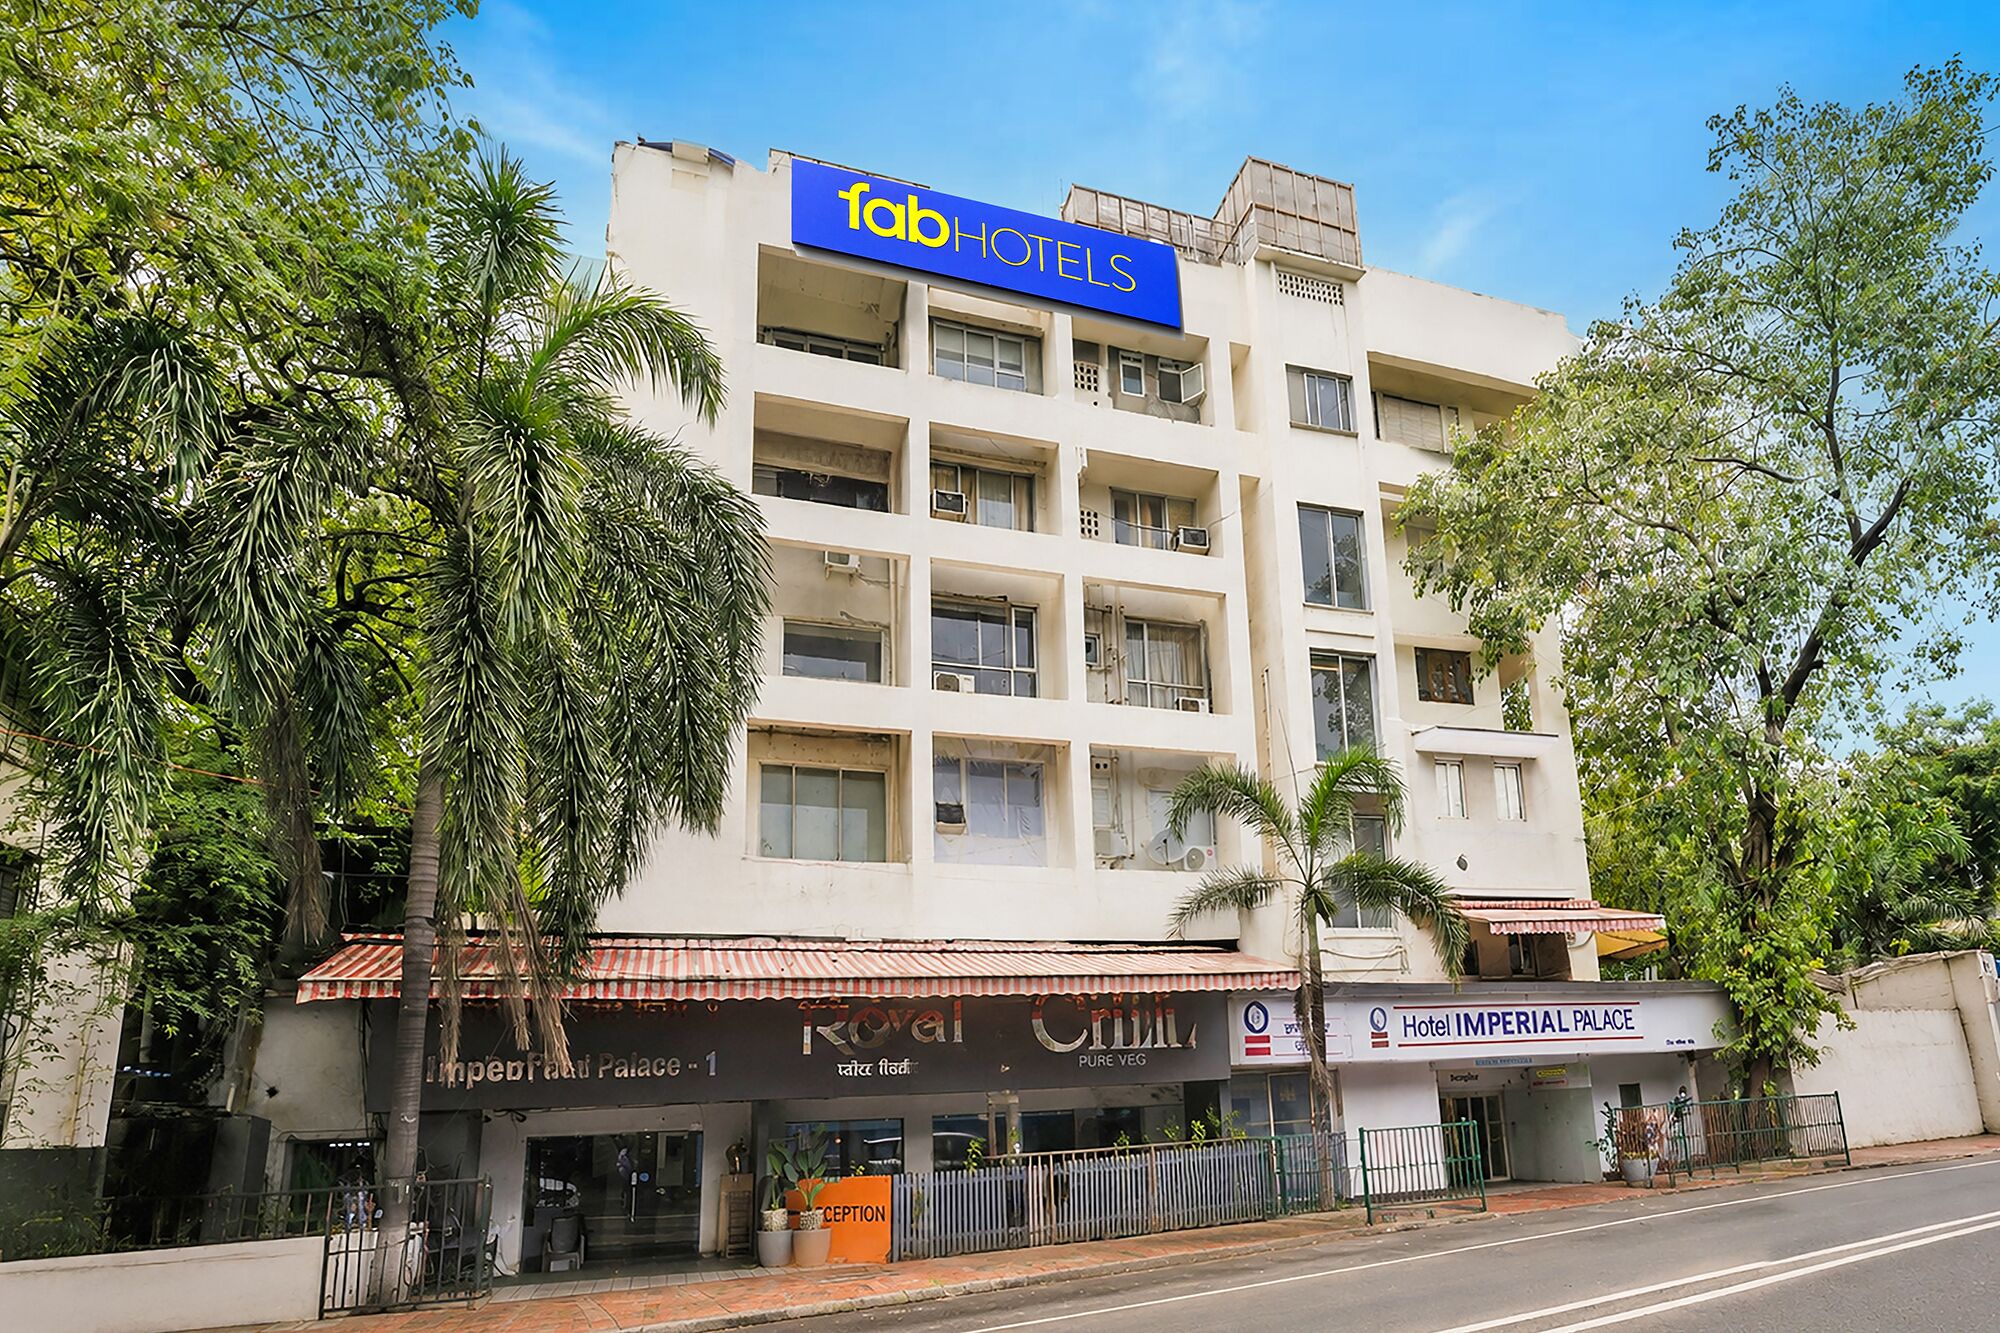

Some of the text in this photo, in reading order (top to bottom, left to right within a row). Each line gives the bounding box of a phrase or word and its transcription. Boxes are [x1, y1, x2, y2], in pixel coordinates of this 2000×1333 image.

[1402, 1008, 1635, 1038] Hotel IMPERIAL PALACE
[598, 1053, 681, 1080] Palace
[705, 1051, 717, 1077] 1
[1078, 1053, 1147, 1068] PURE VEG
